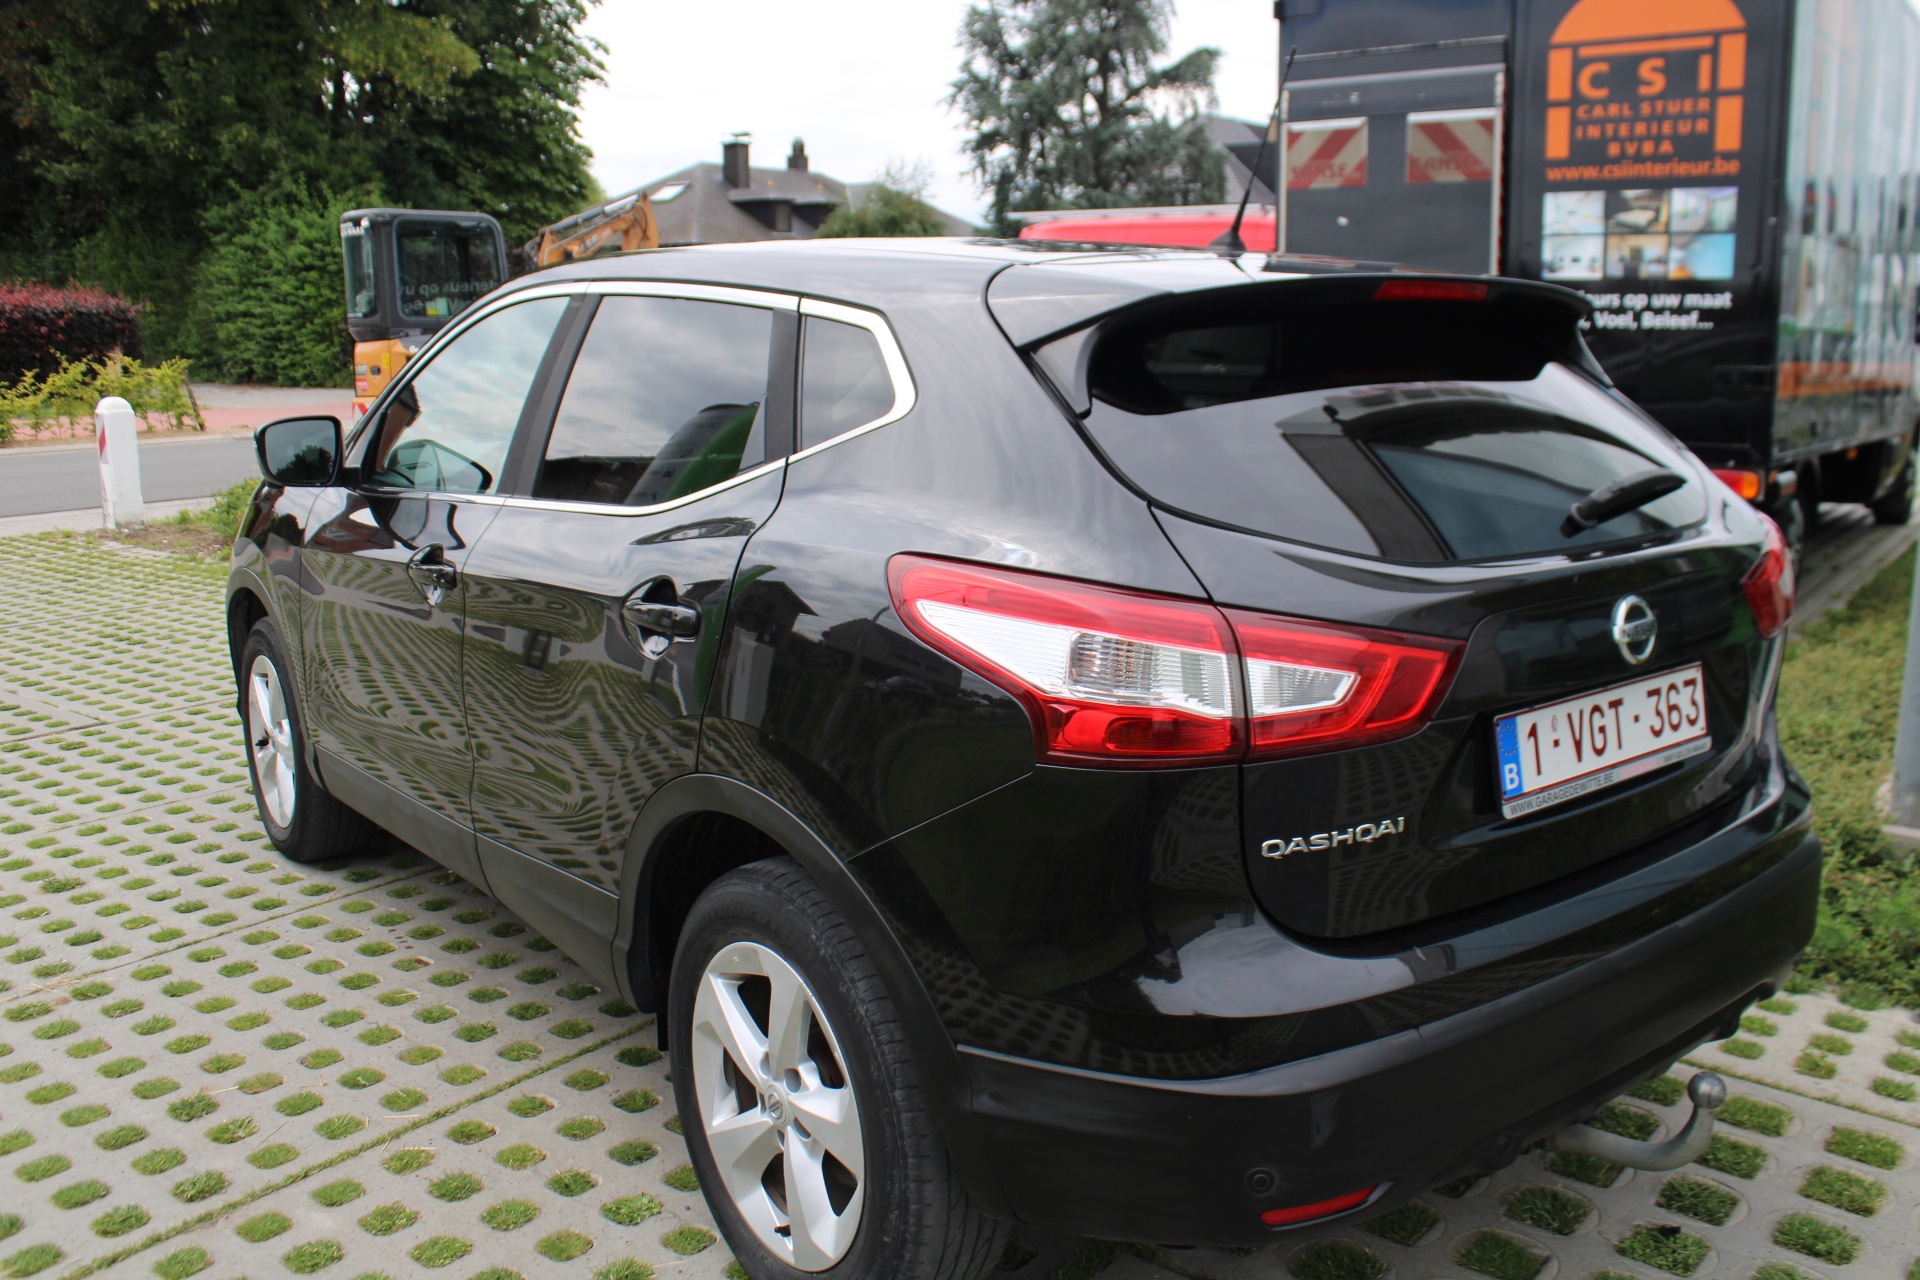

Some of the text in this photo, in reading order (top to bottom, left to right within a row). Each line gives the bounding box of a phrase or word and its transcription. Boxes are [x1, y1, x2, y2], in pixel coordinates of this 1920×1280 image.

[1576, 97, 1711, 120] CARL STUER
[1576, 117, 1710, 140] INTERIEUR
[1607, 139, 1674, 158] BVBA
[1546, 156, 1741, 181] www.csiinterieur.be
[1623, 293, 1648, 312] op
[1650, 293, 1682, 309] uw
[1683, 290, 1732, 309] maat
[1593, 311, 1638, 331] Voel,
[1503, 763, 1520, 790] B
[1509, 771, 1615, 816] WWW.GARAGEDEWITTE.BE
[1261, 816, 1405, 859] QASHQAI
